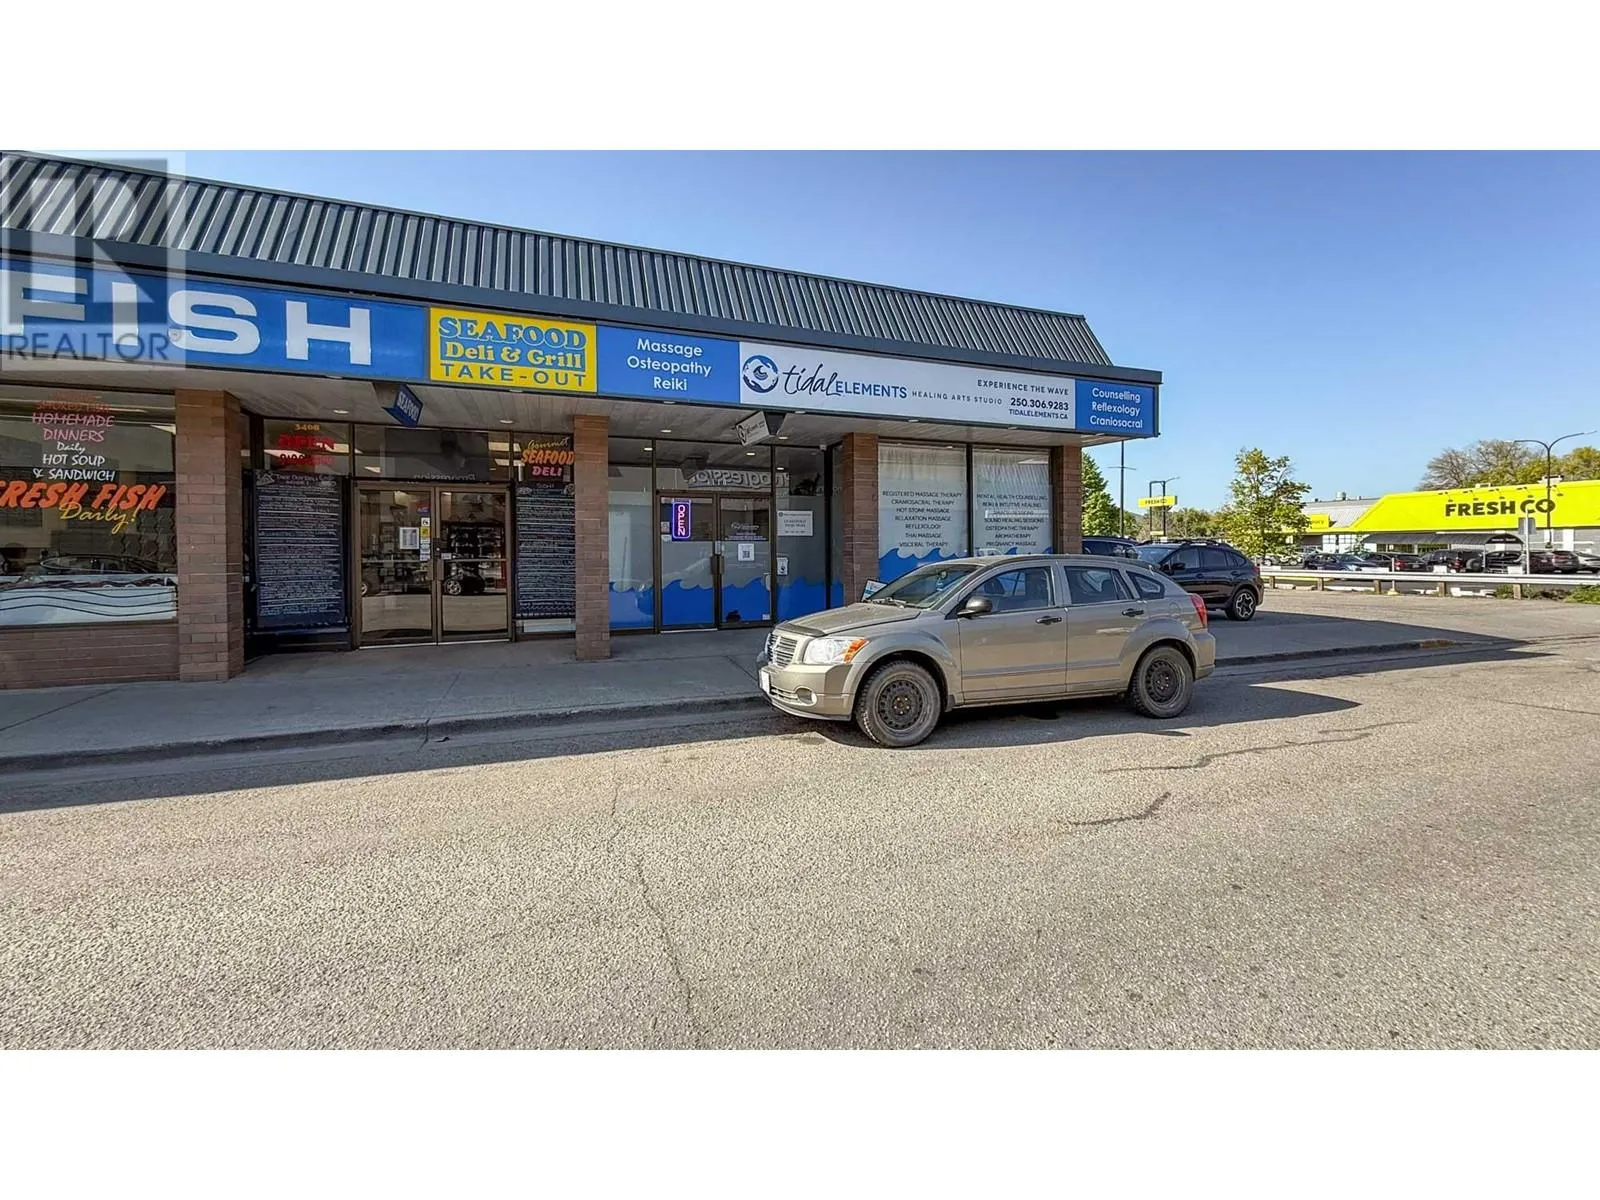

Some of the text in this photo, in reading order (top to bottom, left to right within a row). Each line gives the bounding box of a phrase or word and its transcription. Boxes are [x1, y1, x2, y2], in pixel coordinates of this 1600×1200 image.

[0, 269, 372, 366] FISH
[438, 316, 587, 350] SEAFOOD
[445, 341, 582, 369] Deli & Grill
[637, 338, 703, 357] Massage
[626, 355, 712, 377] Osteopathy
[440, 363, 586, 387] TAKE-OUT
[653, 376, 688, 391] Reiki
[977, 380, 1069, 396] EXPERIENCE THE WAVE
[912, 391, 948, 400] HEALING
[951, 394, 971, 402] ARTS
[974, 396, 1003, 405] STUDIO
[1092, 387, 1141, 403] Counselling
[1010, 397, 1069, 411] 250.306.9283
[1092, 401, 1141, 417] Reflexology
[32, 412, 116, 427] HOMEMADE
[1090, 415, 1143, 428] Craniosacral
[43, 428, 105, 442] DINNERS
[56, 442, 86, 454] Daily
[42, 454, 106, 467] HOT SOUP
[521, 450, 575, 466] SEAFOOD
[33, 468, 116, 482] & SANDWICH
[532, 465, 562, 477] DELI
[91, 483, 167, 510] FISH
[677, 504, 686, 537] OPEN
